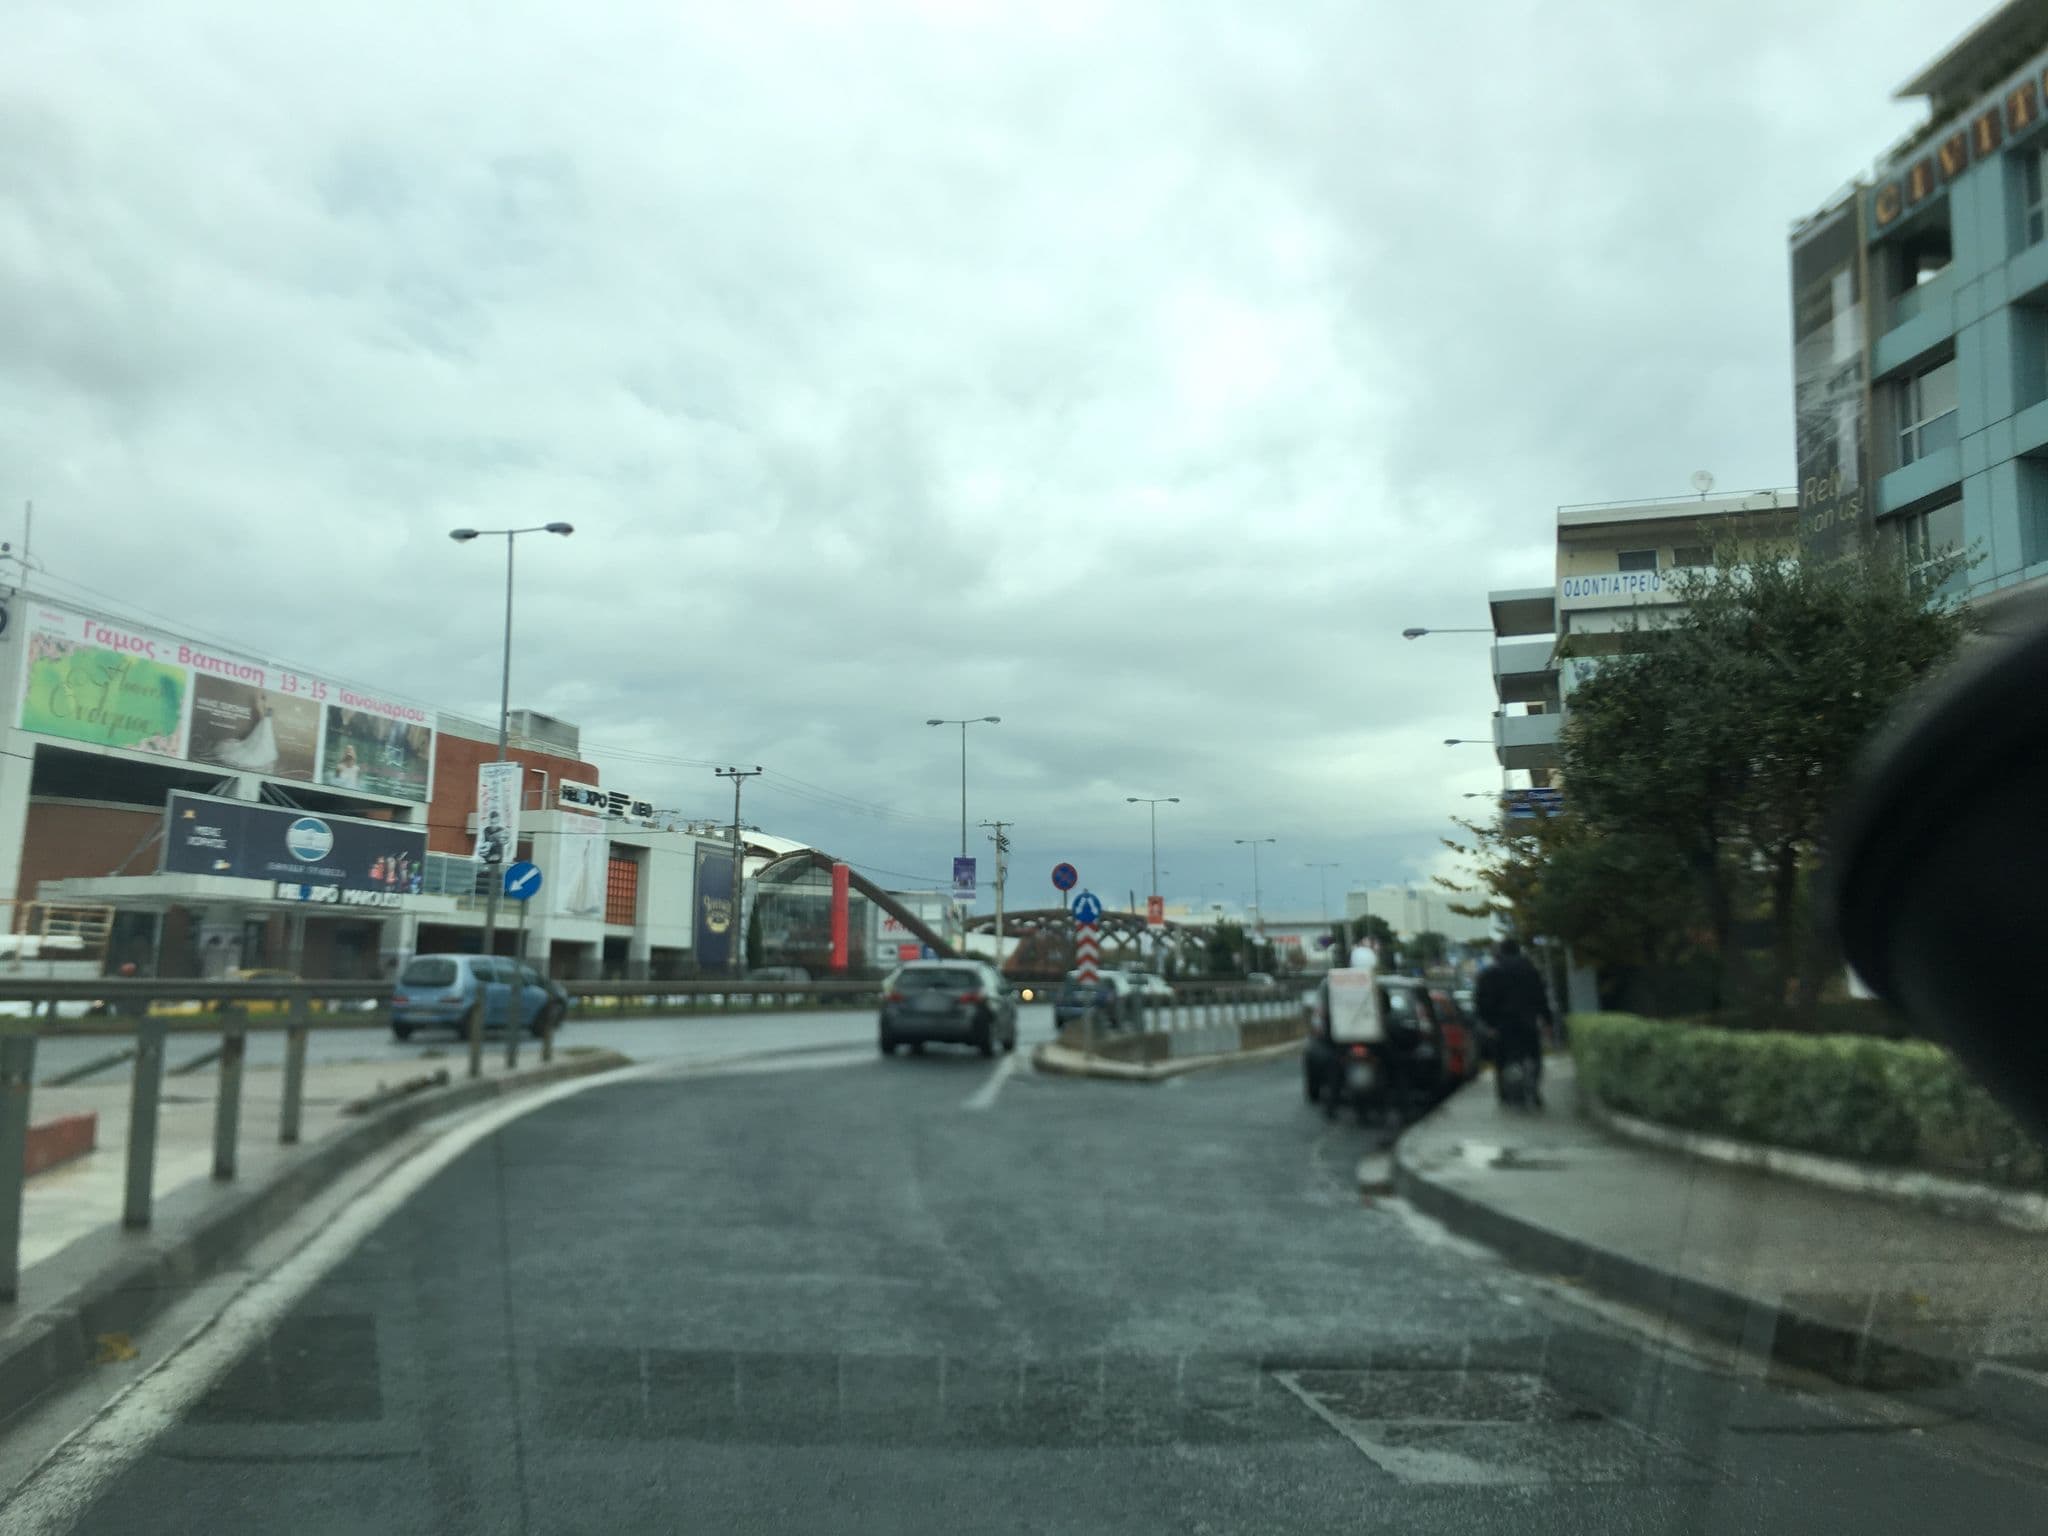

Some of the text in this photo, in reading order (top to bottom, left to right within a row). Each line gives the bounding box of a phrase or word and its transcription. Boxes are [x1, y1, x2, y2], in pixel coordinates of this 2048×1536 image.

[1876, 68, 2048, 225] CIVIT
[1563, 575, 1660, 597] ΟΔΟΝΤΙΑΤΡΕΙΟ
[83, 619, 156, 659] Γαμος
[178, 645, 265, 687] Βαπτιση
[280, 673, 297, 693] 13
[311, 679, 327, 699] 15
[339, 687, 425, 722] Ιανουαριου
